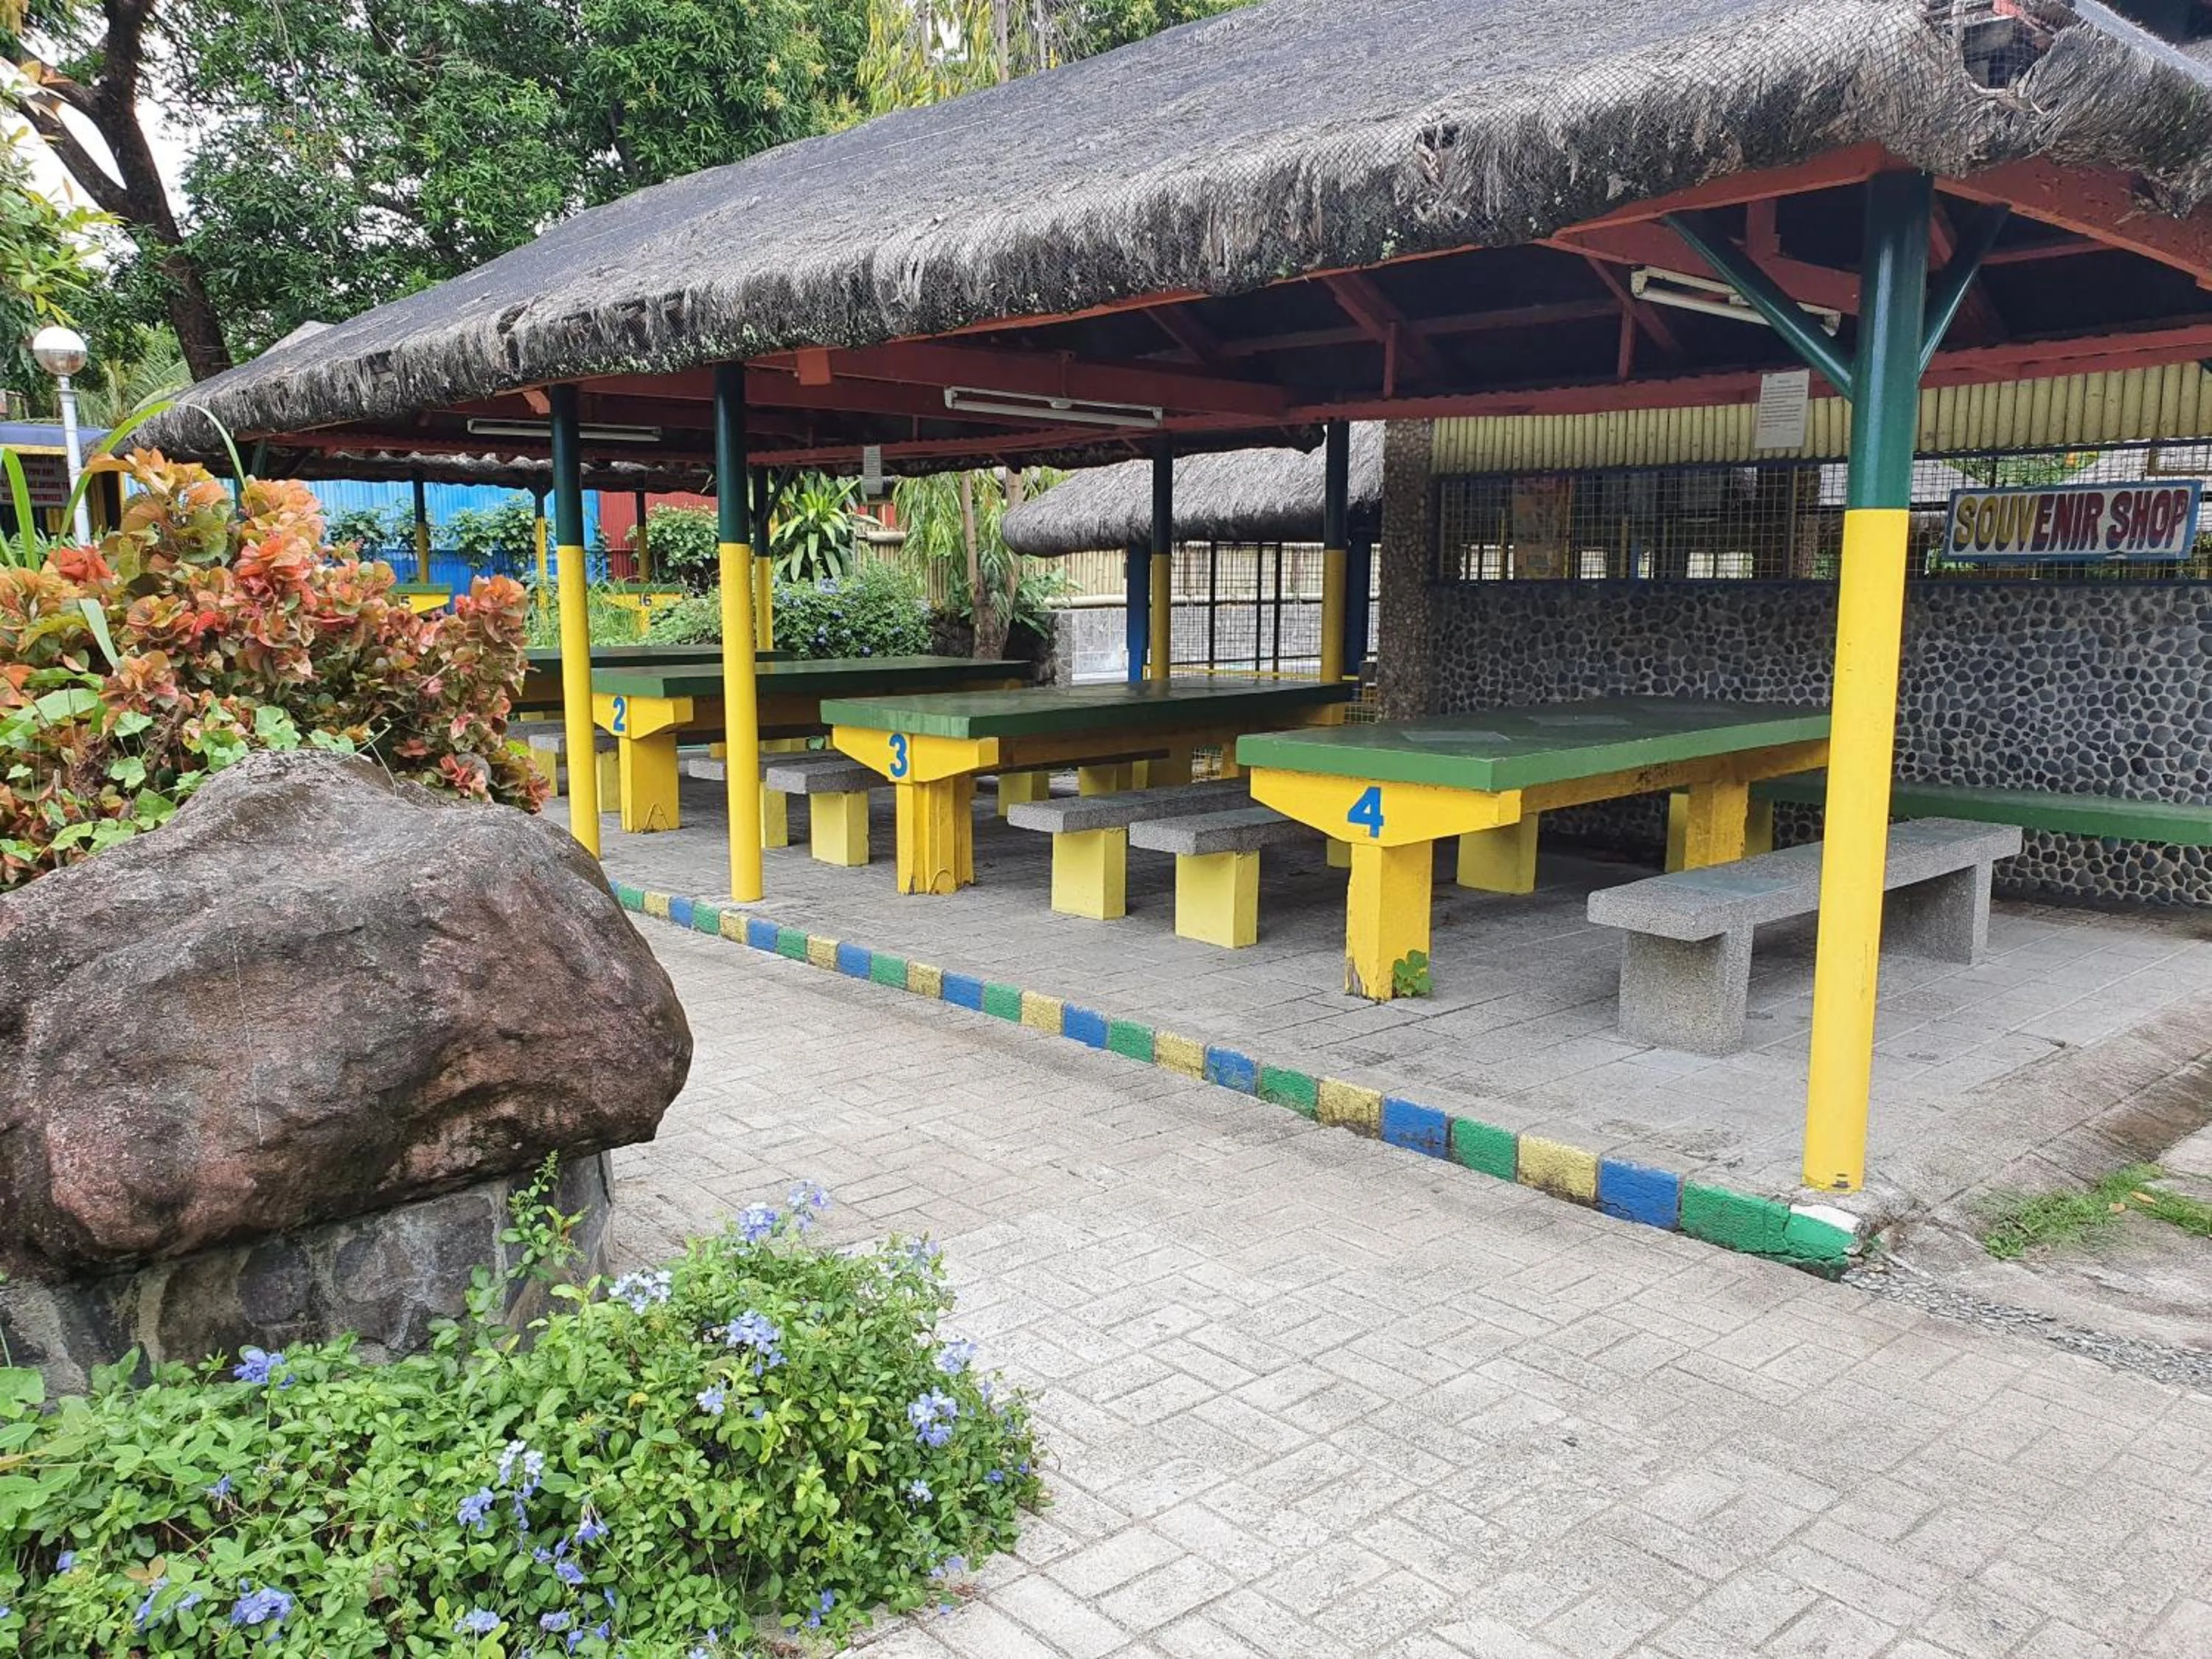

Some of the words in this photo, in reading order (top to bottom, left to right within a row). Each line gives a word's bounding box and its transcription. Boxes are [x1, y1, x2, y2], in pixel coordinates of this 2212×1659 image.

[1954, 493, 2104, 552] SOUVENIR
[2106, 490, 2189, 550] SHOP
[638, 593, 653, 607] 16
[613, 695, 626, 732] 2
[889, 732, 908, 778] 3
[1347, 786, 1384, 838] 4
